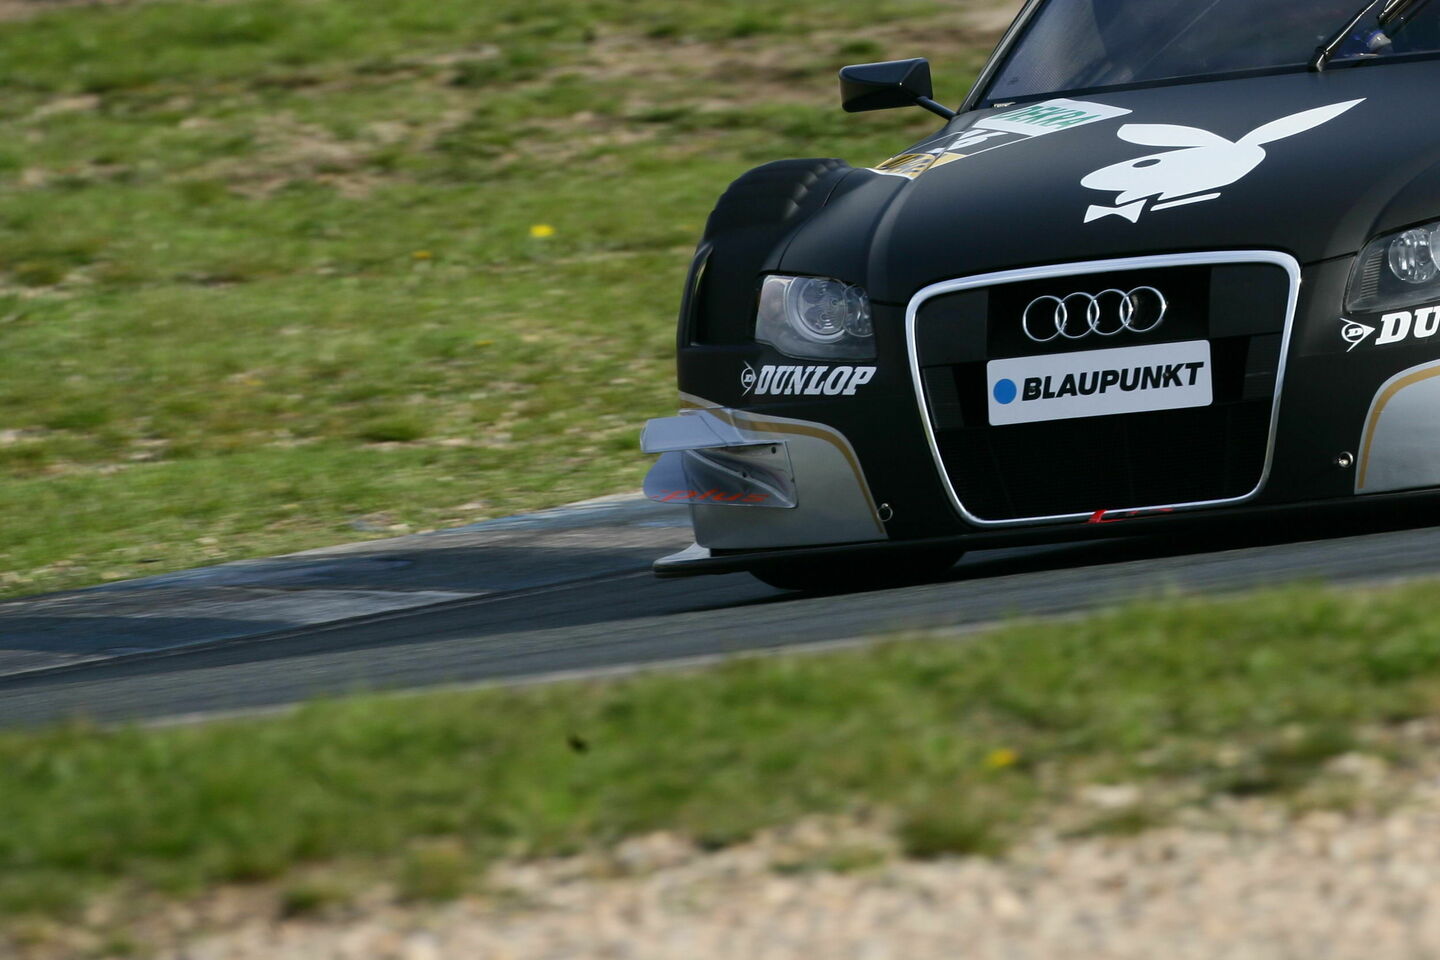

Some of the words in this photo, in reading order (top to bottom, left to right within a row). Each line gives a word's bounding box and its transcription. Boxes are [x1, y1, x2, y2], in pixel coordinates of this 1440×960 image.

[990, 105, 1102, 130] DEKRA
[754, 365, 877, 395] DUNLOP
[1021, 361, 1204, 402] BLAUPUNKT
